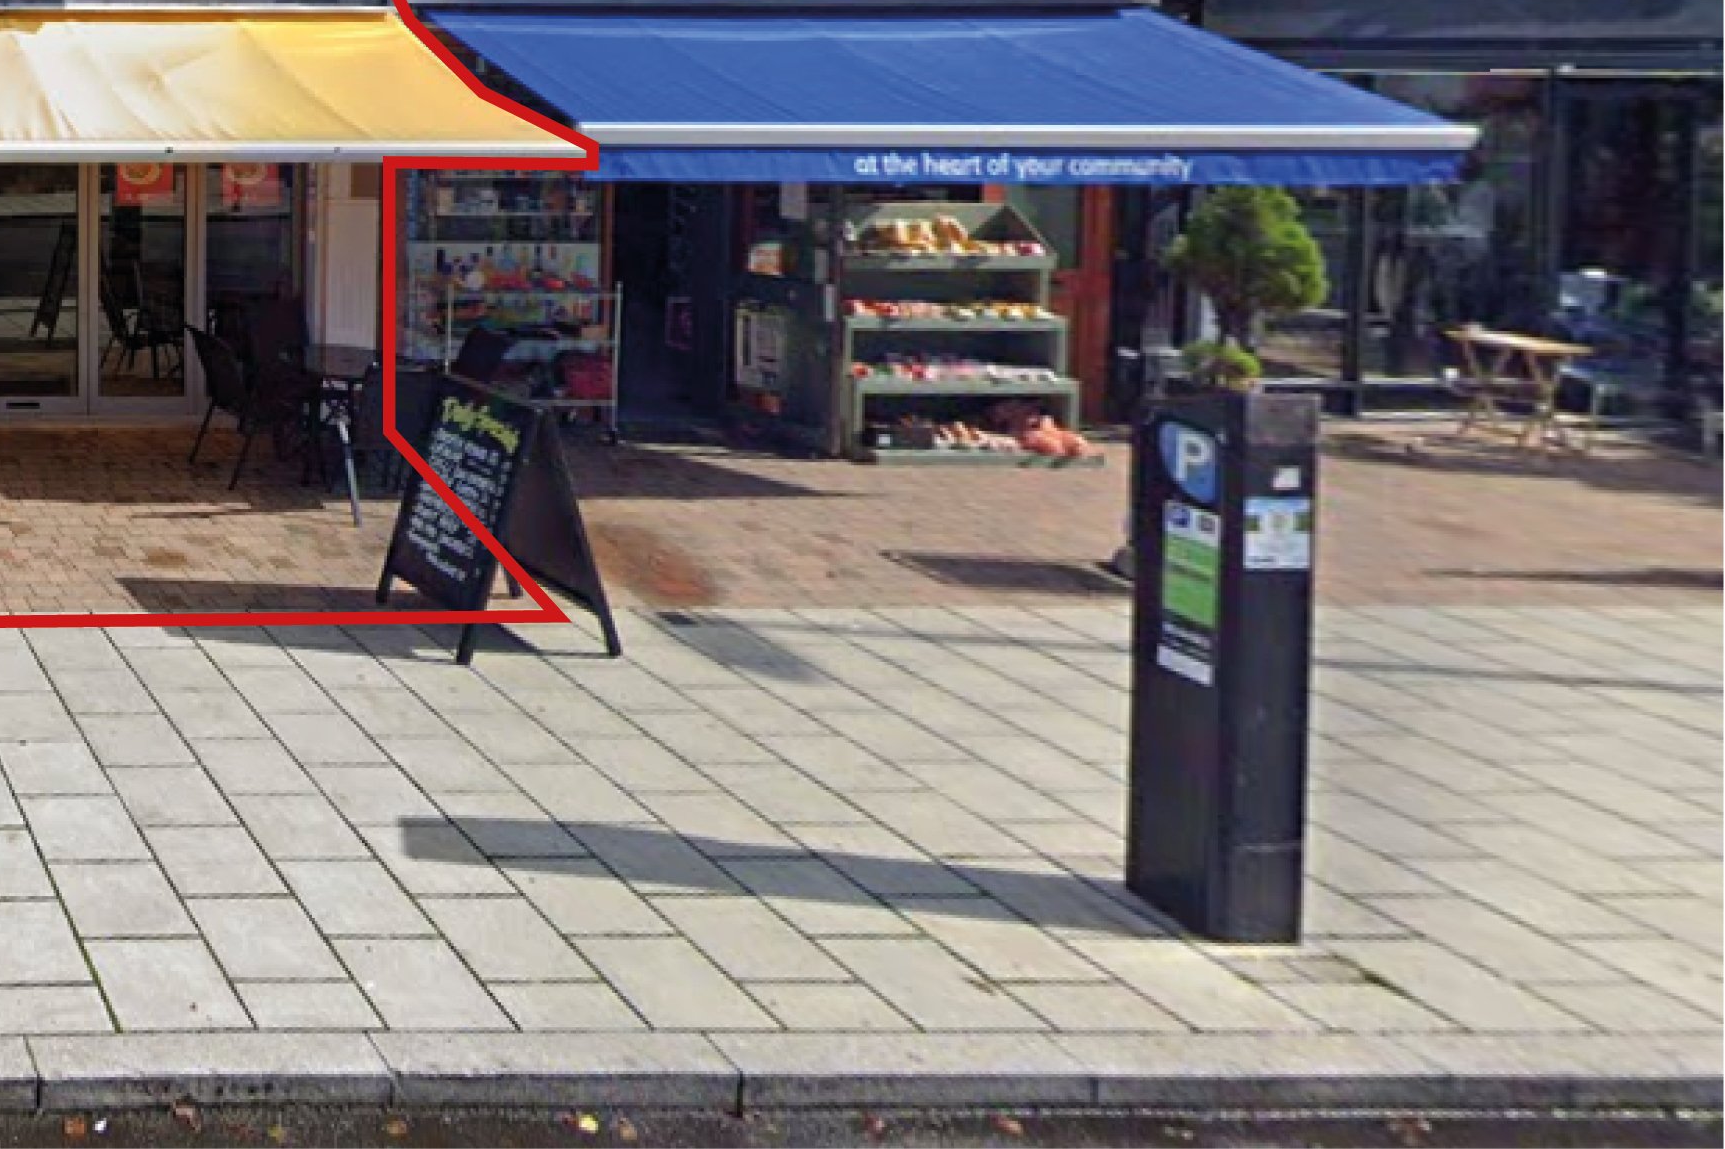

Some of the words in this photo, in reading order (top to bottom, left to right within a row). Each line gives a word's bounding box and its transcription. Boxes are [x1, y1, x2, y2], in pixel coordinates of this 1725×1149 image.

[853, 154, 878, 176] at
[881, 150, 918, 176] the
[921, 150, 982, 176] heart
[986, 151, 1011, 176] of
[1014, 157, 1064, 181] your
[1068, 153, 1194, 182] community
[1178, 429, 1212, 484] P
